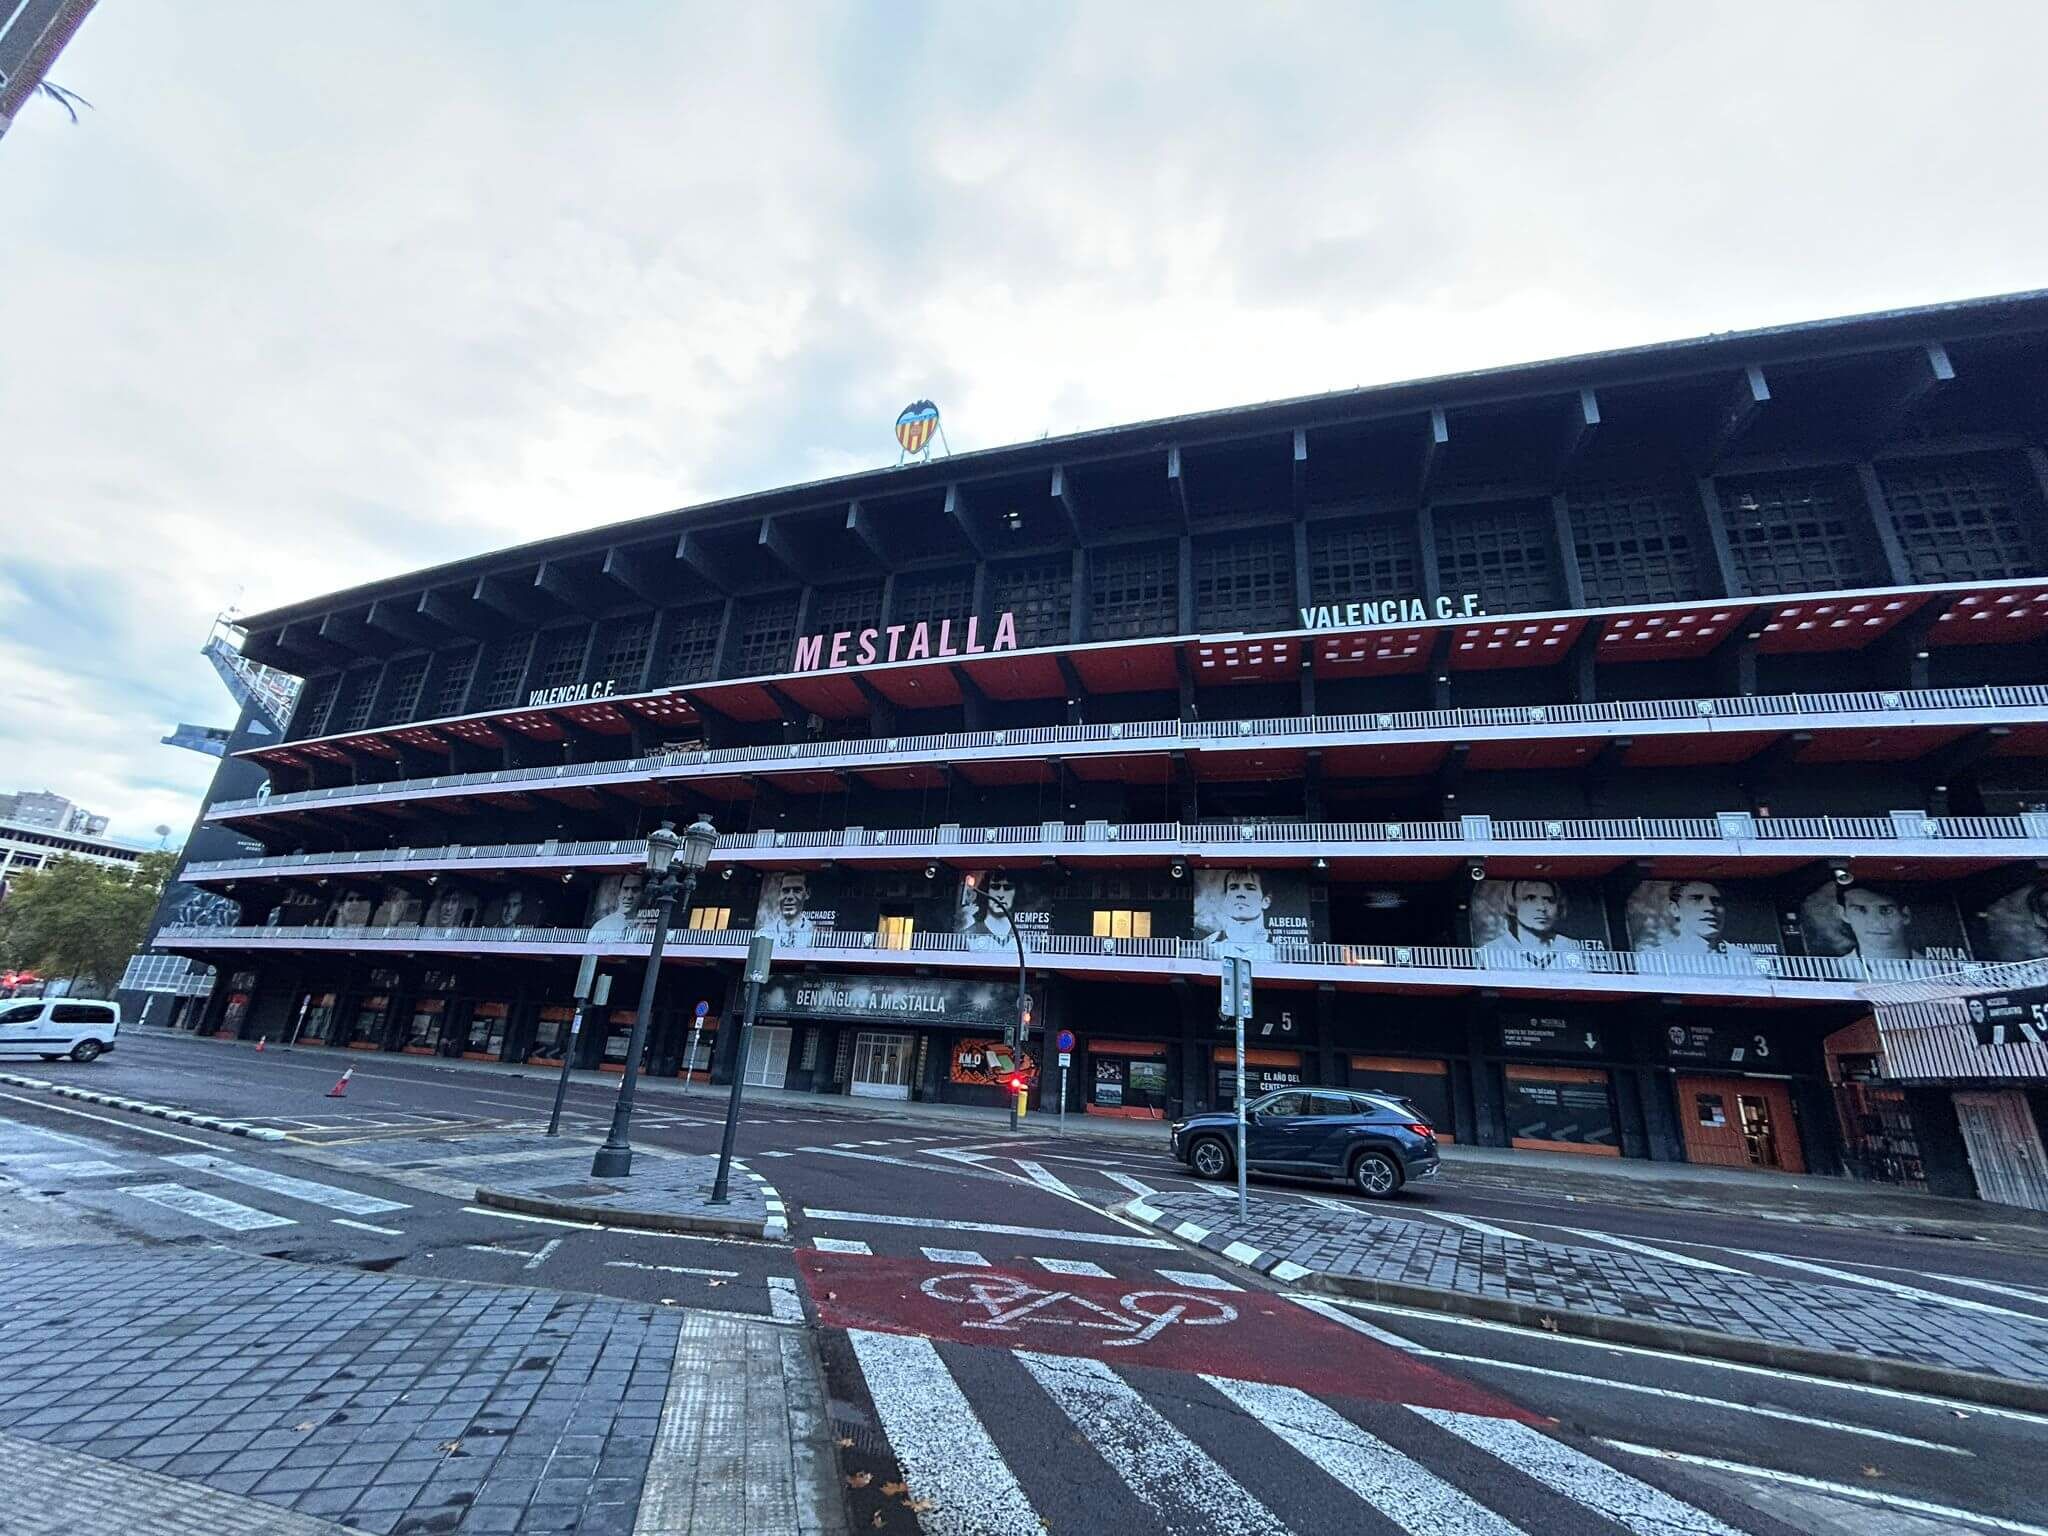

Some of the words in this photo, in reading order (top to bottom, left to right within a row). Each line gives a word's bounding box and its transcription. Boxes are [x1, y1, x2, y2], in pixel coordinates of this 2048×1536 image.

[1300, 598, 1427, 630] VALENCIA
[1436, 593, 1486, 620] C.F.
[793, 611, 1018, 673] MESTALLA
[528, 683, 589, 706] VALENCIA
[591, 679, 616, 700] C.F.
[1014, 911, 1050, 923] KEMPES
[1268, 917, 1308, 928] ALBELDA
[1271, 936, 1309, 945] MESTALLA
[1718, 942, 1778, 954] CRAMUNT
[1925, 946, 1968, 961] AYALA
[796, 989, 866, 1008] BENVINGUTS
[869, 993, 878, 1009] A
[880, 993, 945, 1013] MESTALLA
[1281, 1011, 1292, 1031] 5
[2030, 1002, 2048, 1032] 5
[1754, 1035, 1769, 1057] 3
[1263, 1072, 1272, 1081] EL
[1287, 1074, 1301, 1083] DEL
